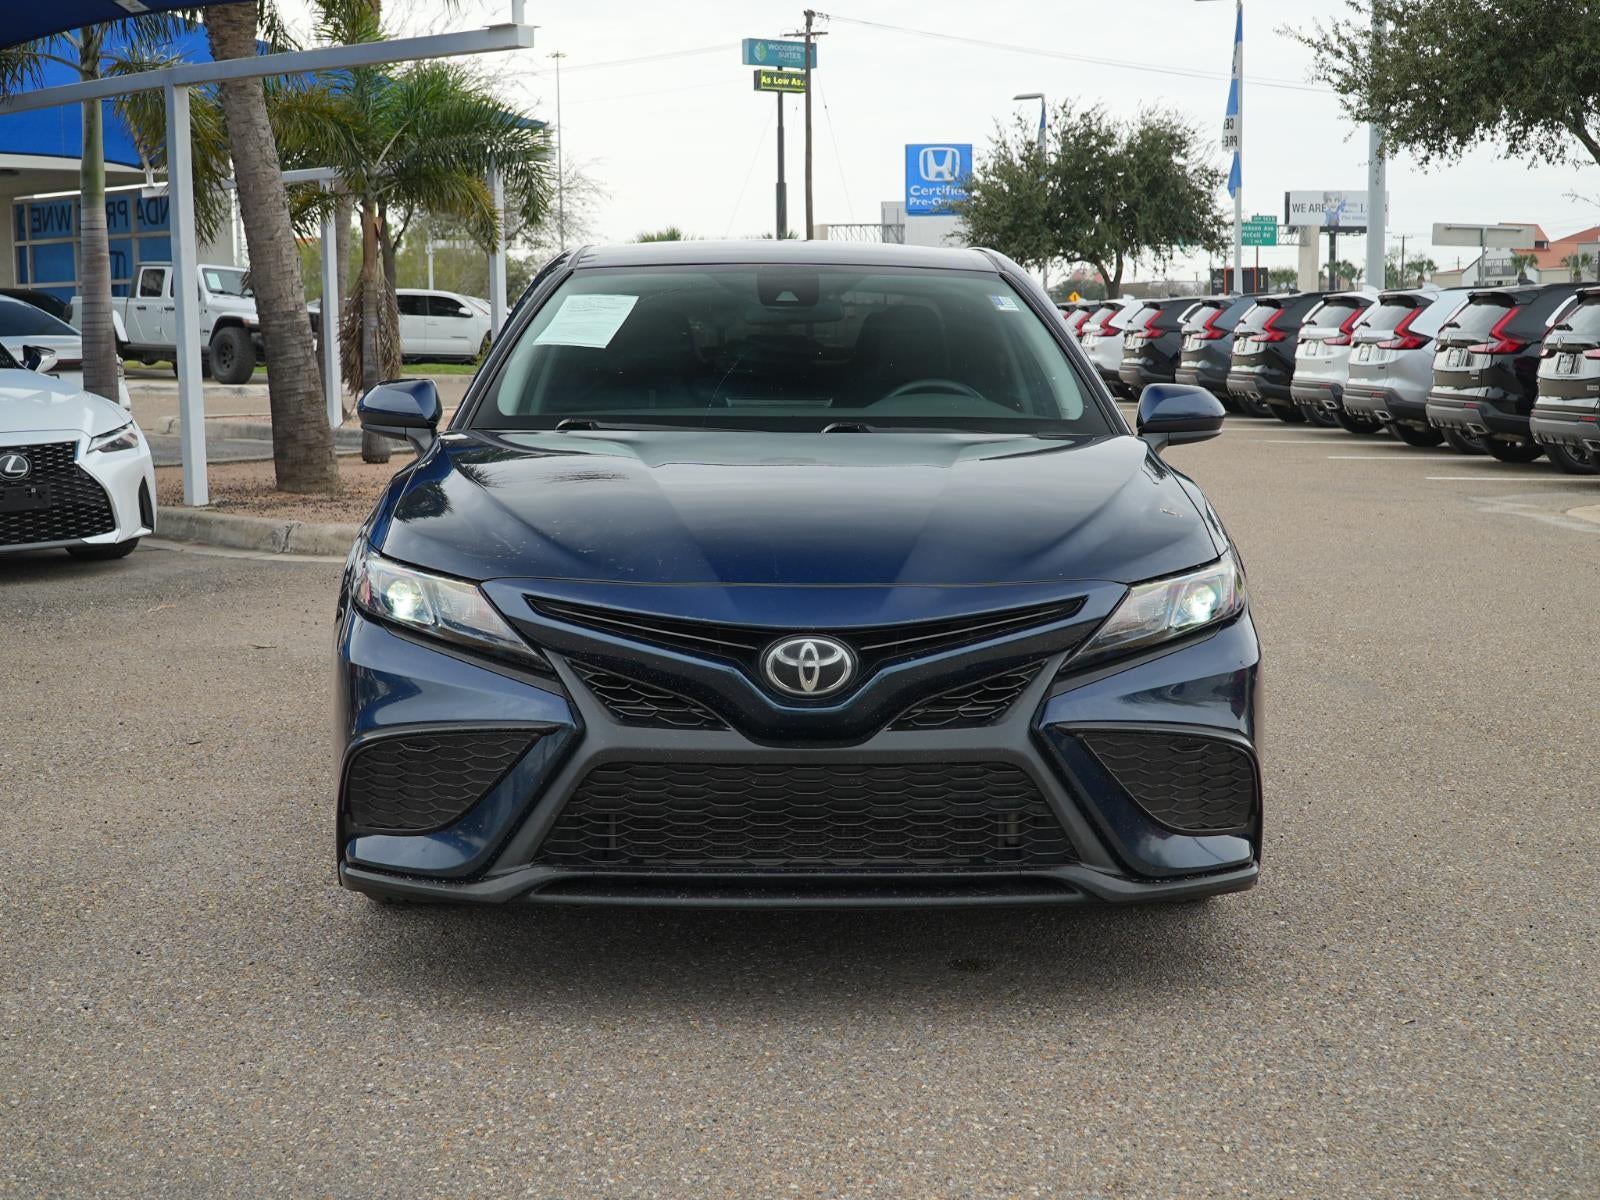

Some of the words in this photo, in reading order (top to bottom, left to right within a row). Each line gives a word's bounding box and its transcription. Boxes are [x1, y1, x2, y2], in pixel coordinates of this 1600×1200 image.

[761, 76, 771, 84] As
[773, 77, 789, 85] Low
[1292, 203, 1306, 213] WE
[1308, 203, 1327, 213] ARE
